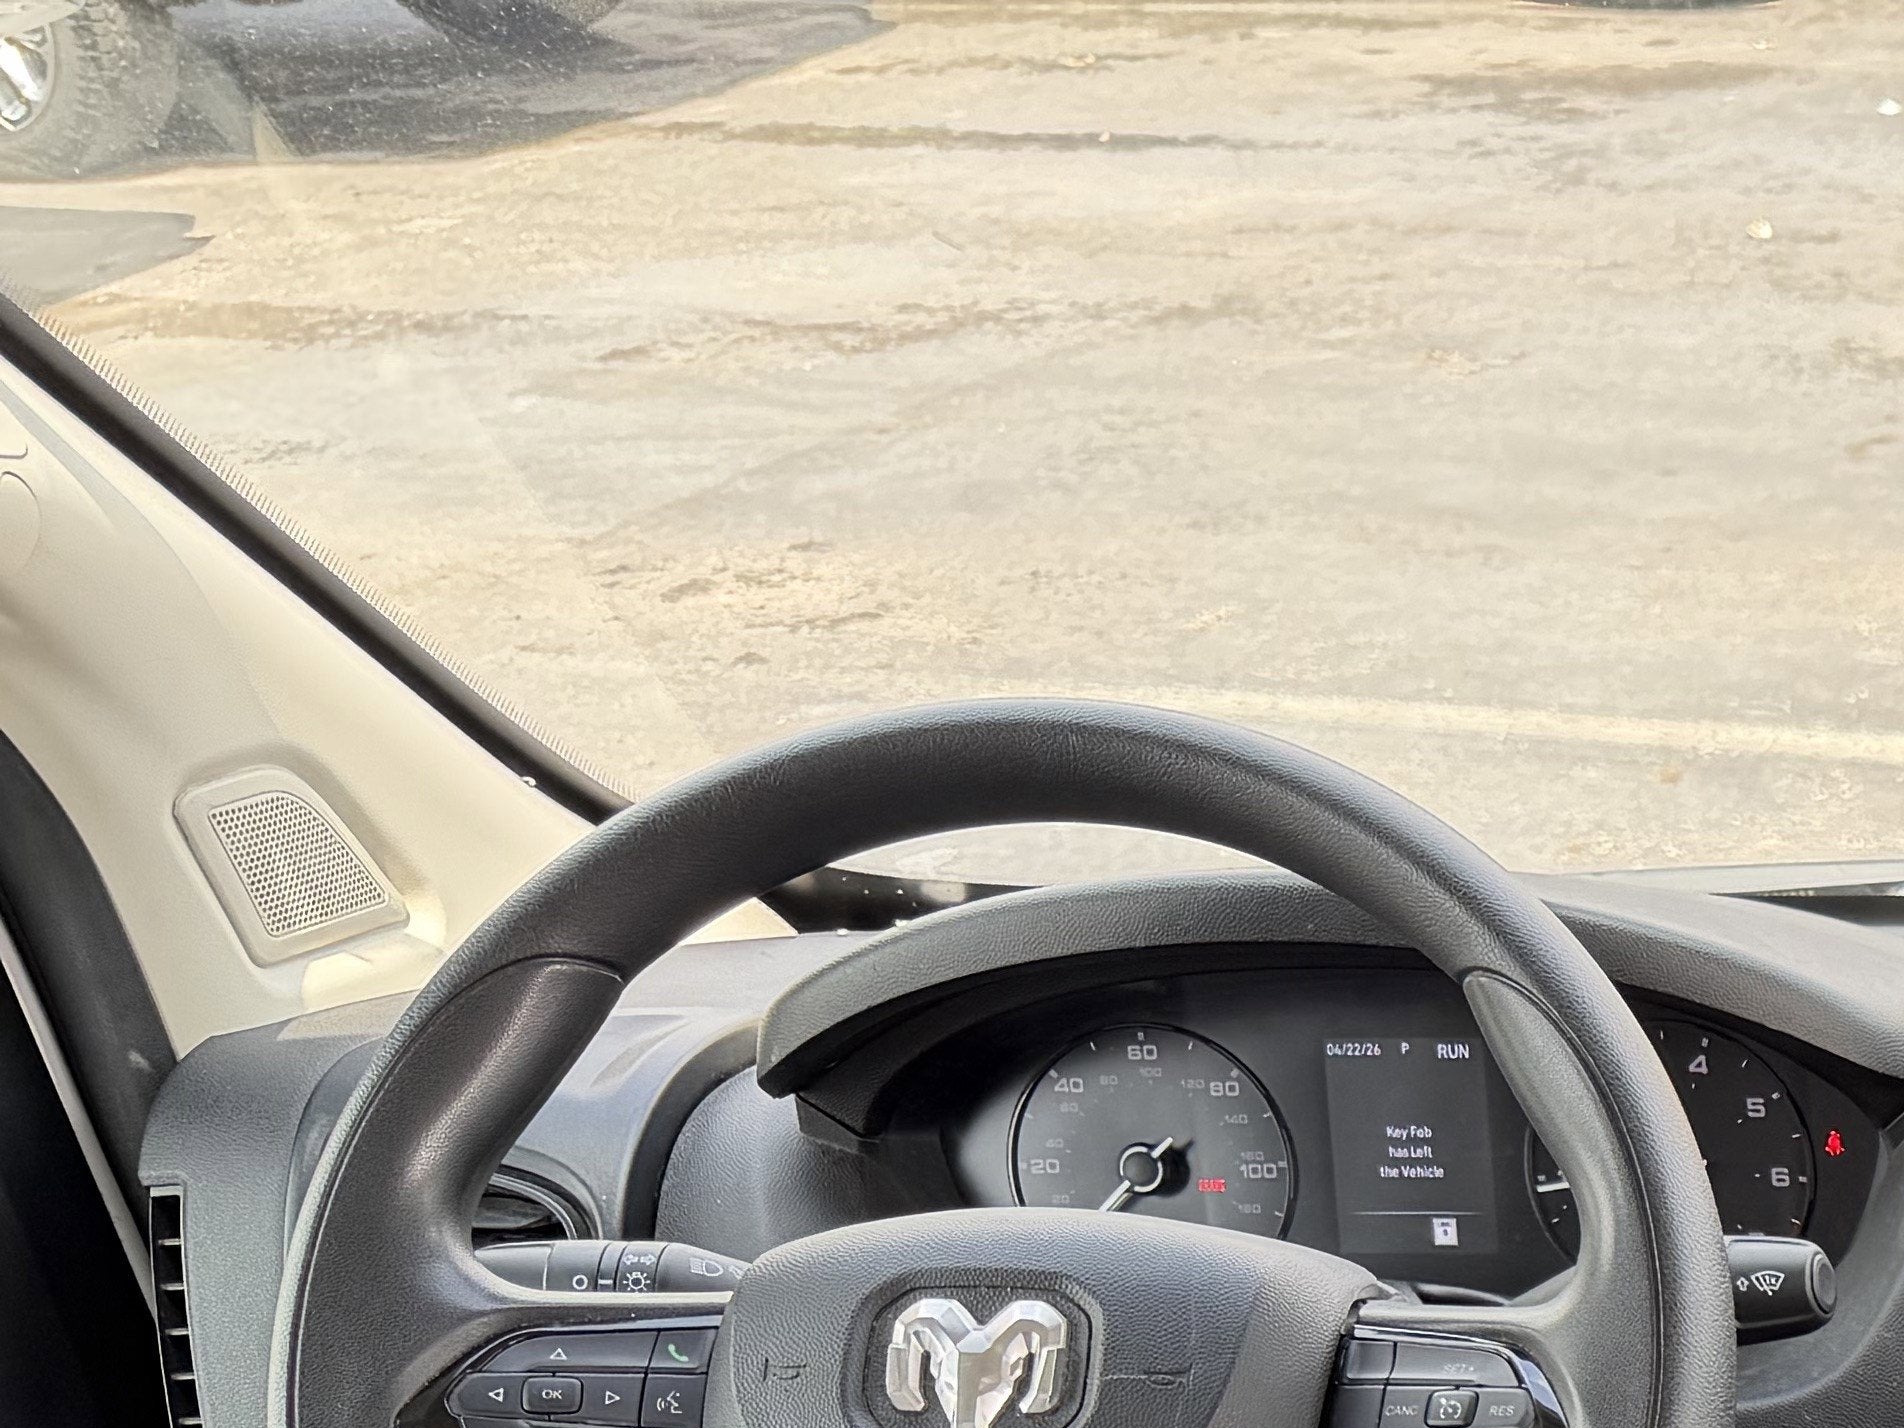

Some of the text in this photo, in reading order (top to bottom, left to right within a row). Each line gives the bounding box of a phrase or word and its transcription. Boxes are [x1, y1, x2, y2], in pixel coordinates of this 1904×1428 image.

[1127, 1045, 1158, 1060] 60
[1326, 1043, 1382, 1056] 04/22/26
[1401, 1042, 1410, 1054] P
[1437, 1044, 1470, 1059] RUN
[1688, 1054, 1709, 1075] 4
[1054, 1077, 1084, 1093] 40
[1746, 1098, 1766, 1118] 5
[1386, 1126, 1433, 1139] Key Fob
[1389, 1145, 1433, 1158] has Left
[1030, 1159, 1060, 1174] 20
[1239, 1163, 1278, 1179] 100
[1380, 1166, 1444, 1178] the Vehicle
[1771, 1167, 1790, 1188] 6
[541, 1388, 562, 1400] OK
[1489, 1405, 1514, 1416] RES
